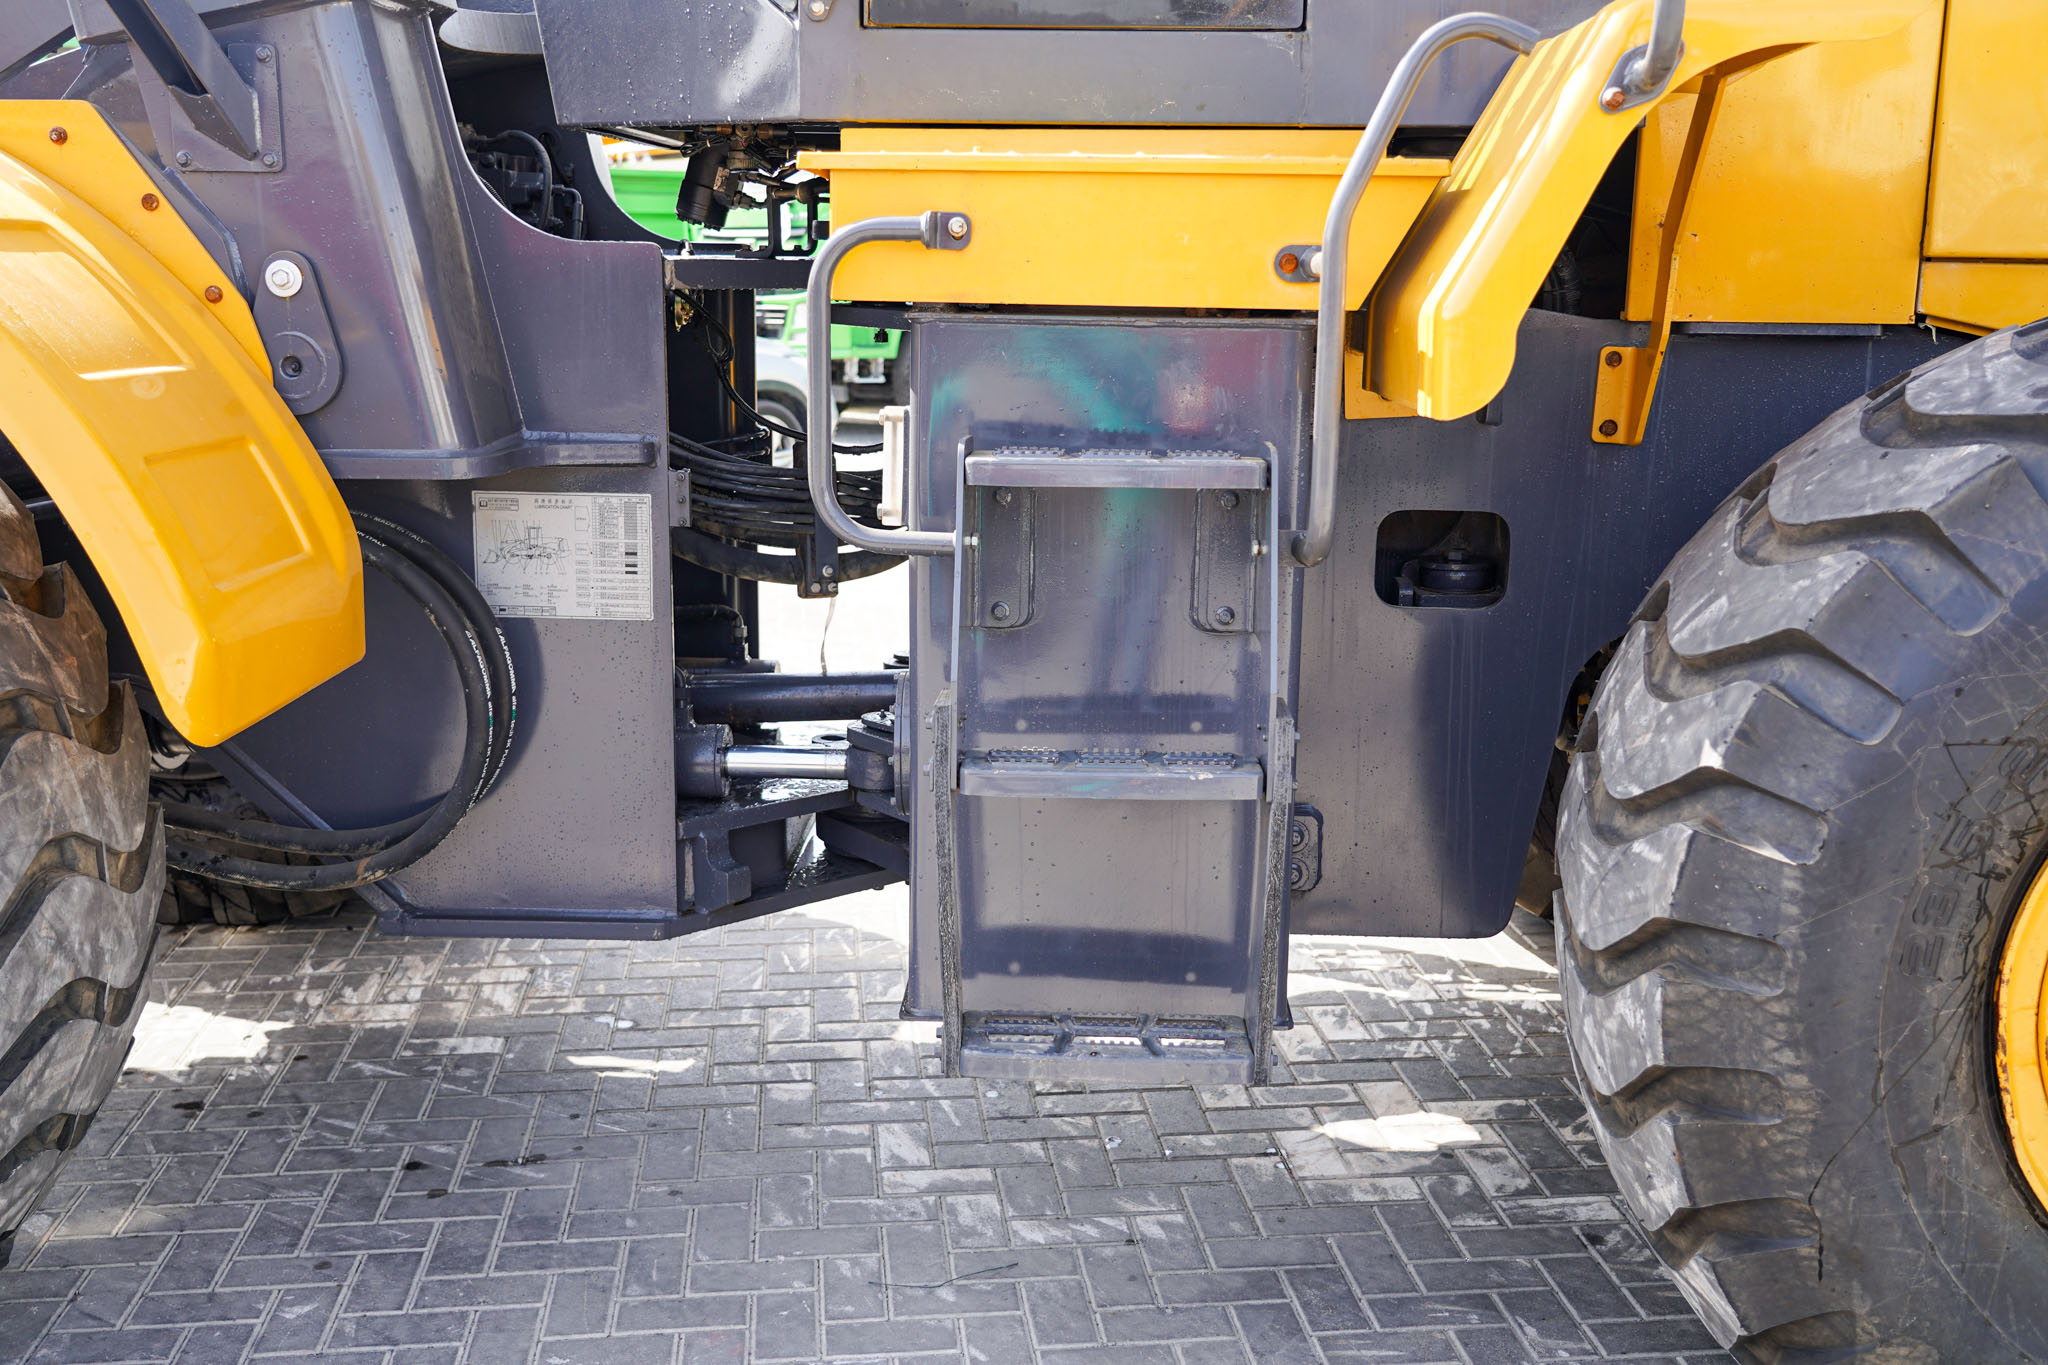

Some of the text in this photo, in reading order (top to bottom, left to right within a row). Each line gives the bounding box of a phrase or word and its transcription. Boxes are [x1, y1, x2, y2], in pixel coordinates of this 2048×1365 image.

[365, 535, 388, 548] ITALY
[373, 516, 397, 529] MADE
[405, 530, 428, 544] ITALY
[469, 638, 492, 699] ALFAGOMMA
[498, 635, 517, 694] ALFAGOMMA
